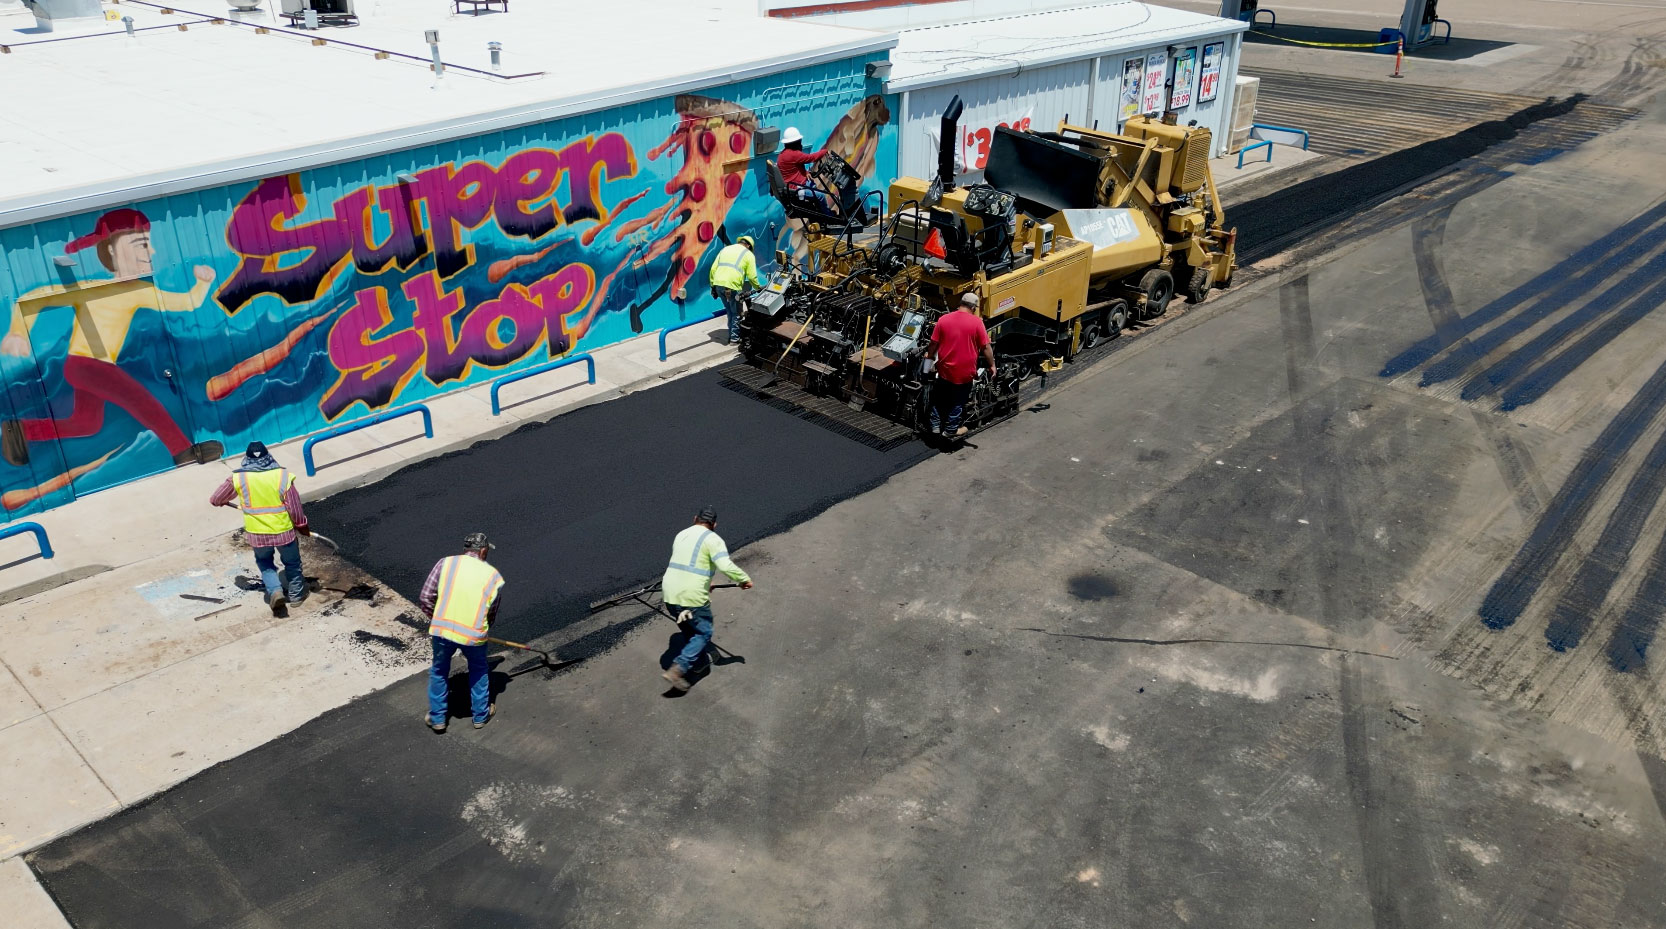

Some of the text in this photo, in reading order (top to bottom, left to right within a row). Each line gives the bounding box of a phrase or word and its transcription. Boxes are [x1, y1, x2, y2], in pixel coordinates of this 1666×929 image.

[212, 131, 638, 316] Super
[1106, 212, 1132, 239] CAT
[318, 262, 596, 422] Stop
